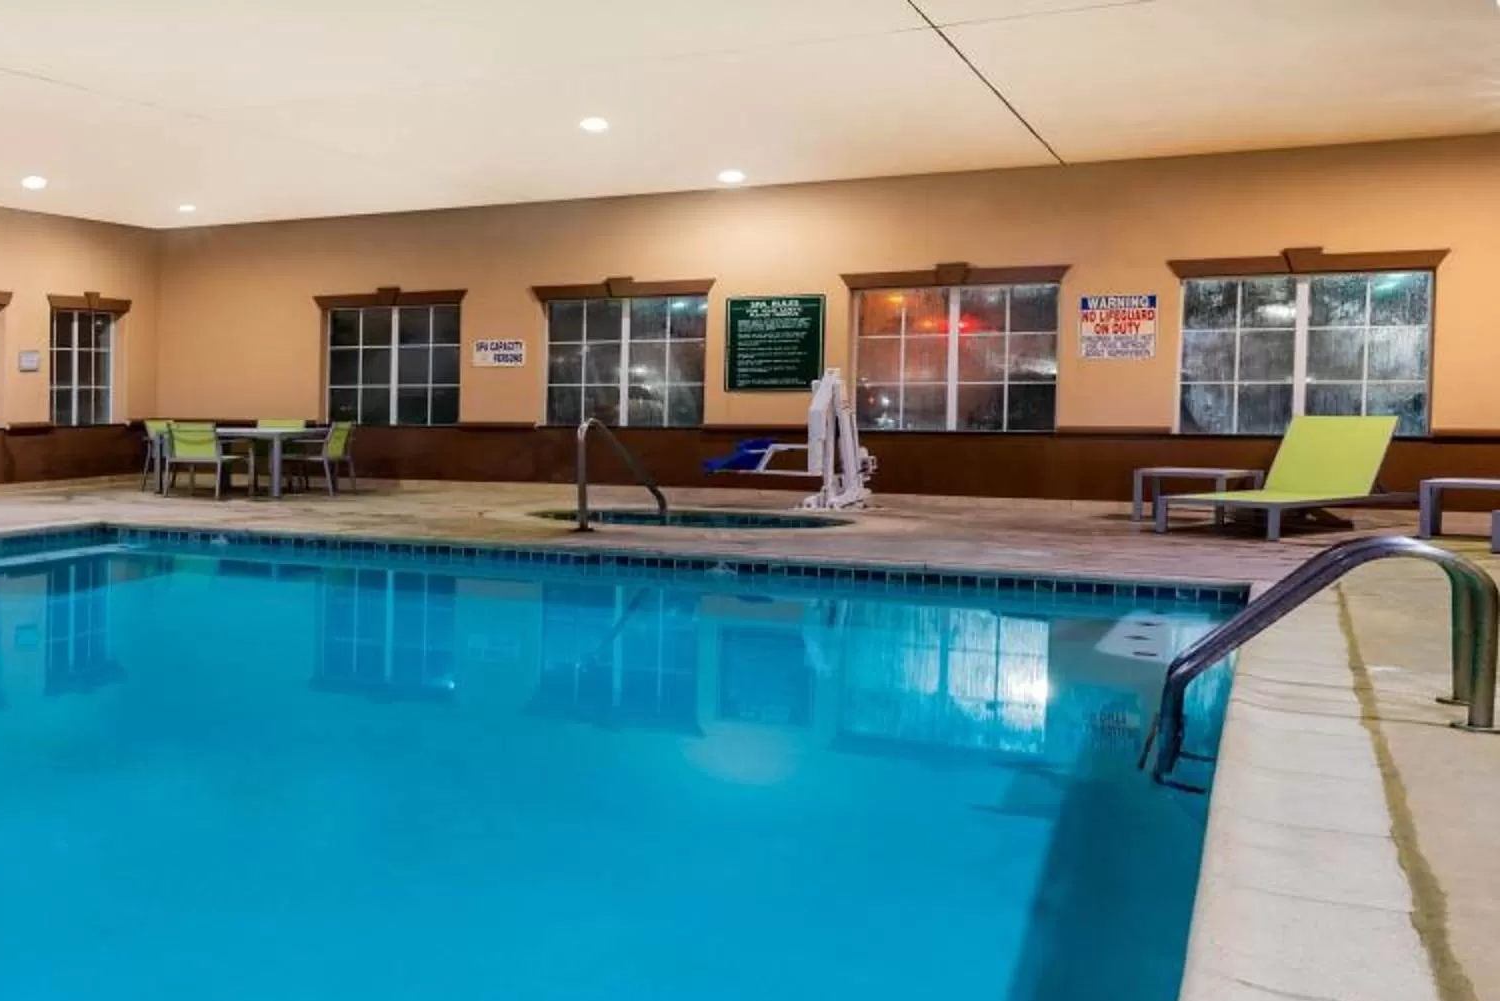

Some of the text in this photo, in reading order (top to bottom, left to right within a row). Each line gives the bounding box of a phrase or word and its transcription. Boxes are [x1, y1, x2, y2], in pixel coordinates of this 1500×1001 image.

[1088, 295, 1148, 309] WARNING
[1081, 309, 1155, 323] NO LIFEGUARD
[1093, 322, 1140, 335] ON DUTY
